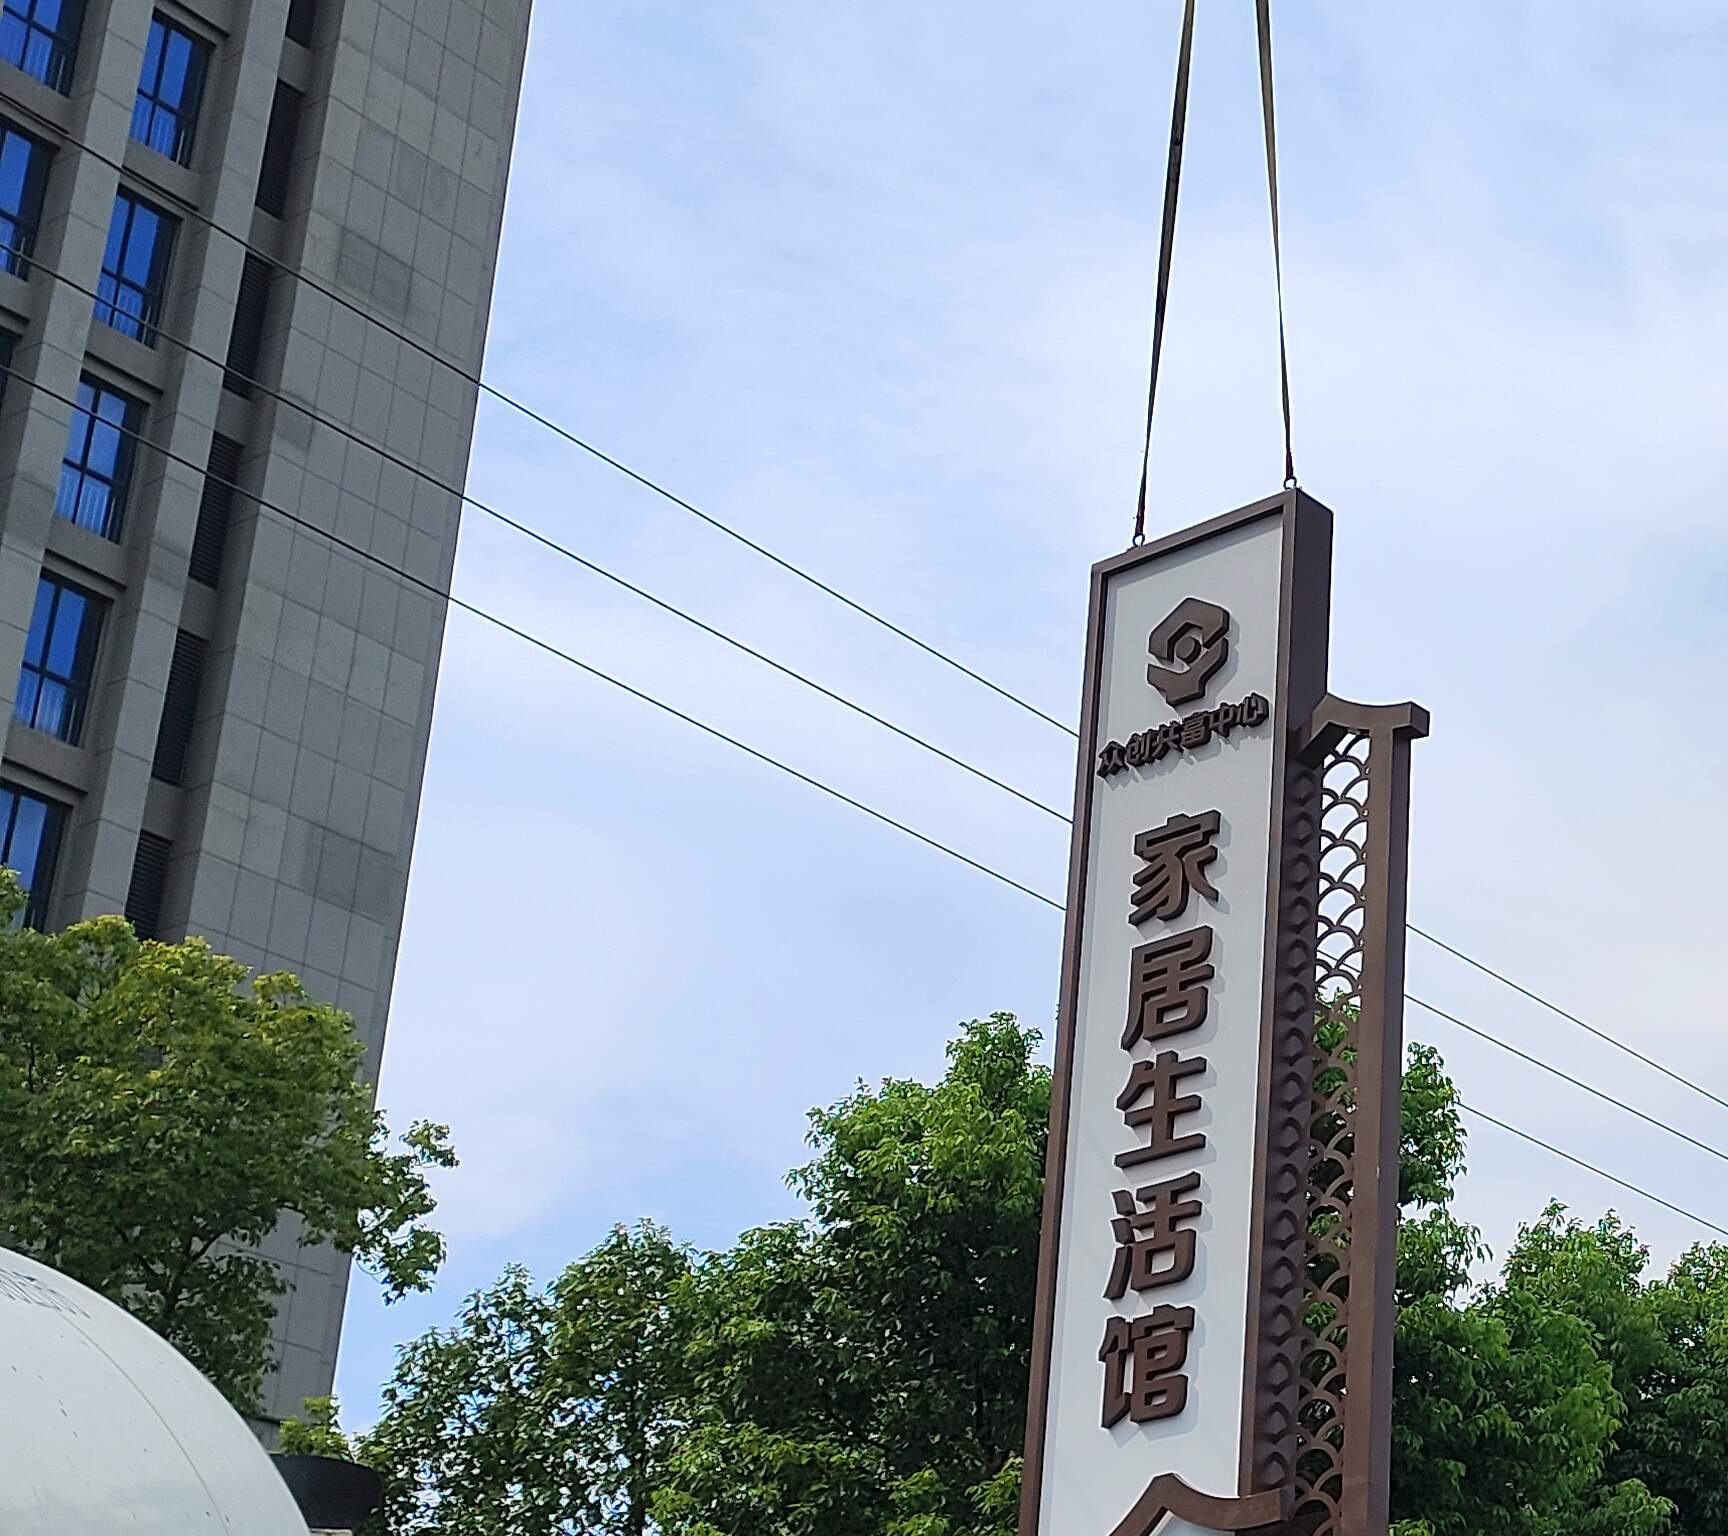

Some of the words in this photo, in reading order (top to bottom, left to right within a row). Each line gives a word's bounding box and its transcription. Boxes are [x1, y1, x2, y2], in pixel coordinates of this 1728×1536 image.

[1096, 692, 1270, 778] 众创共富中心
[1100, 809, 1223, 1430] 家居生活馆
